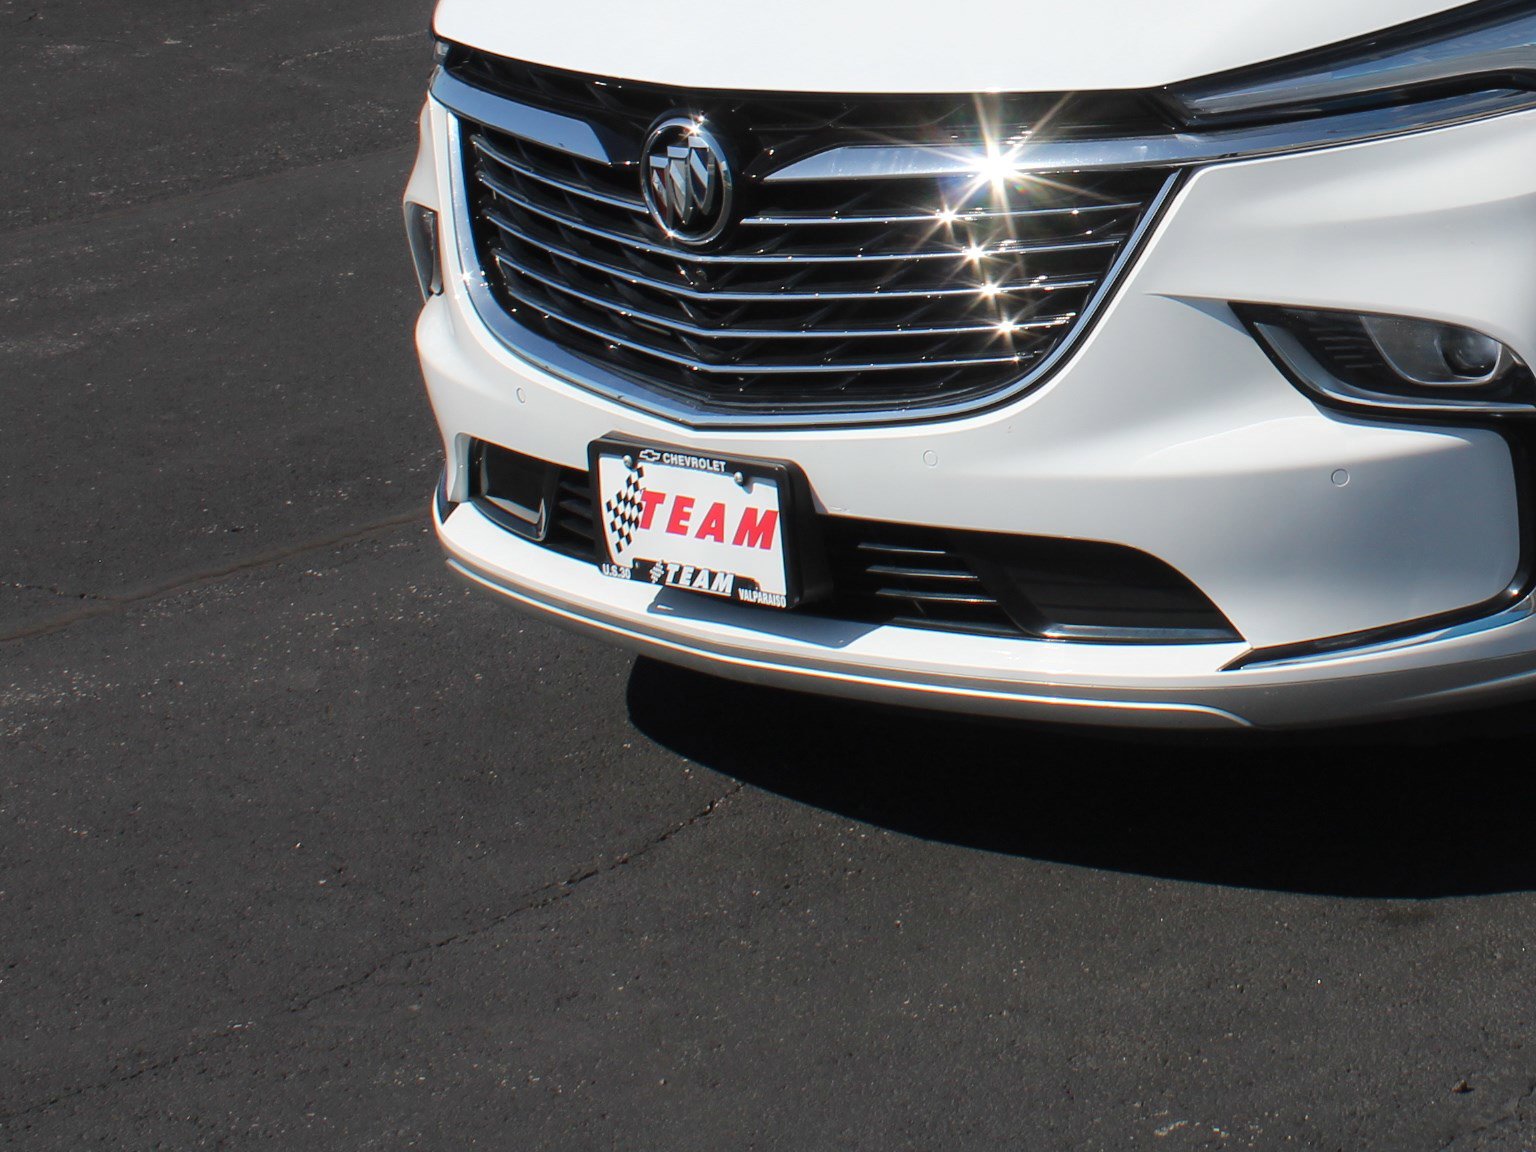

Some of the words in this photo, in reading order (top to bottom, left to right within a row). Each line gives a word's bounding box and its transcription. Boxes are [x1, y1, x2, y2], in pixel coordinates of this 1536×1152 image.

[662, 452, 726, 473] CHEVROLET
[639, 490, 779, 550] TEAM
[665, 563, 735, 594] TEAM
[738, 587, 787, 608] VALPARAISO
